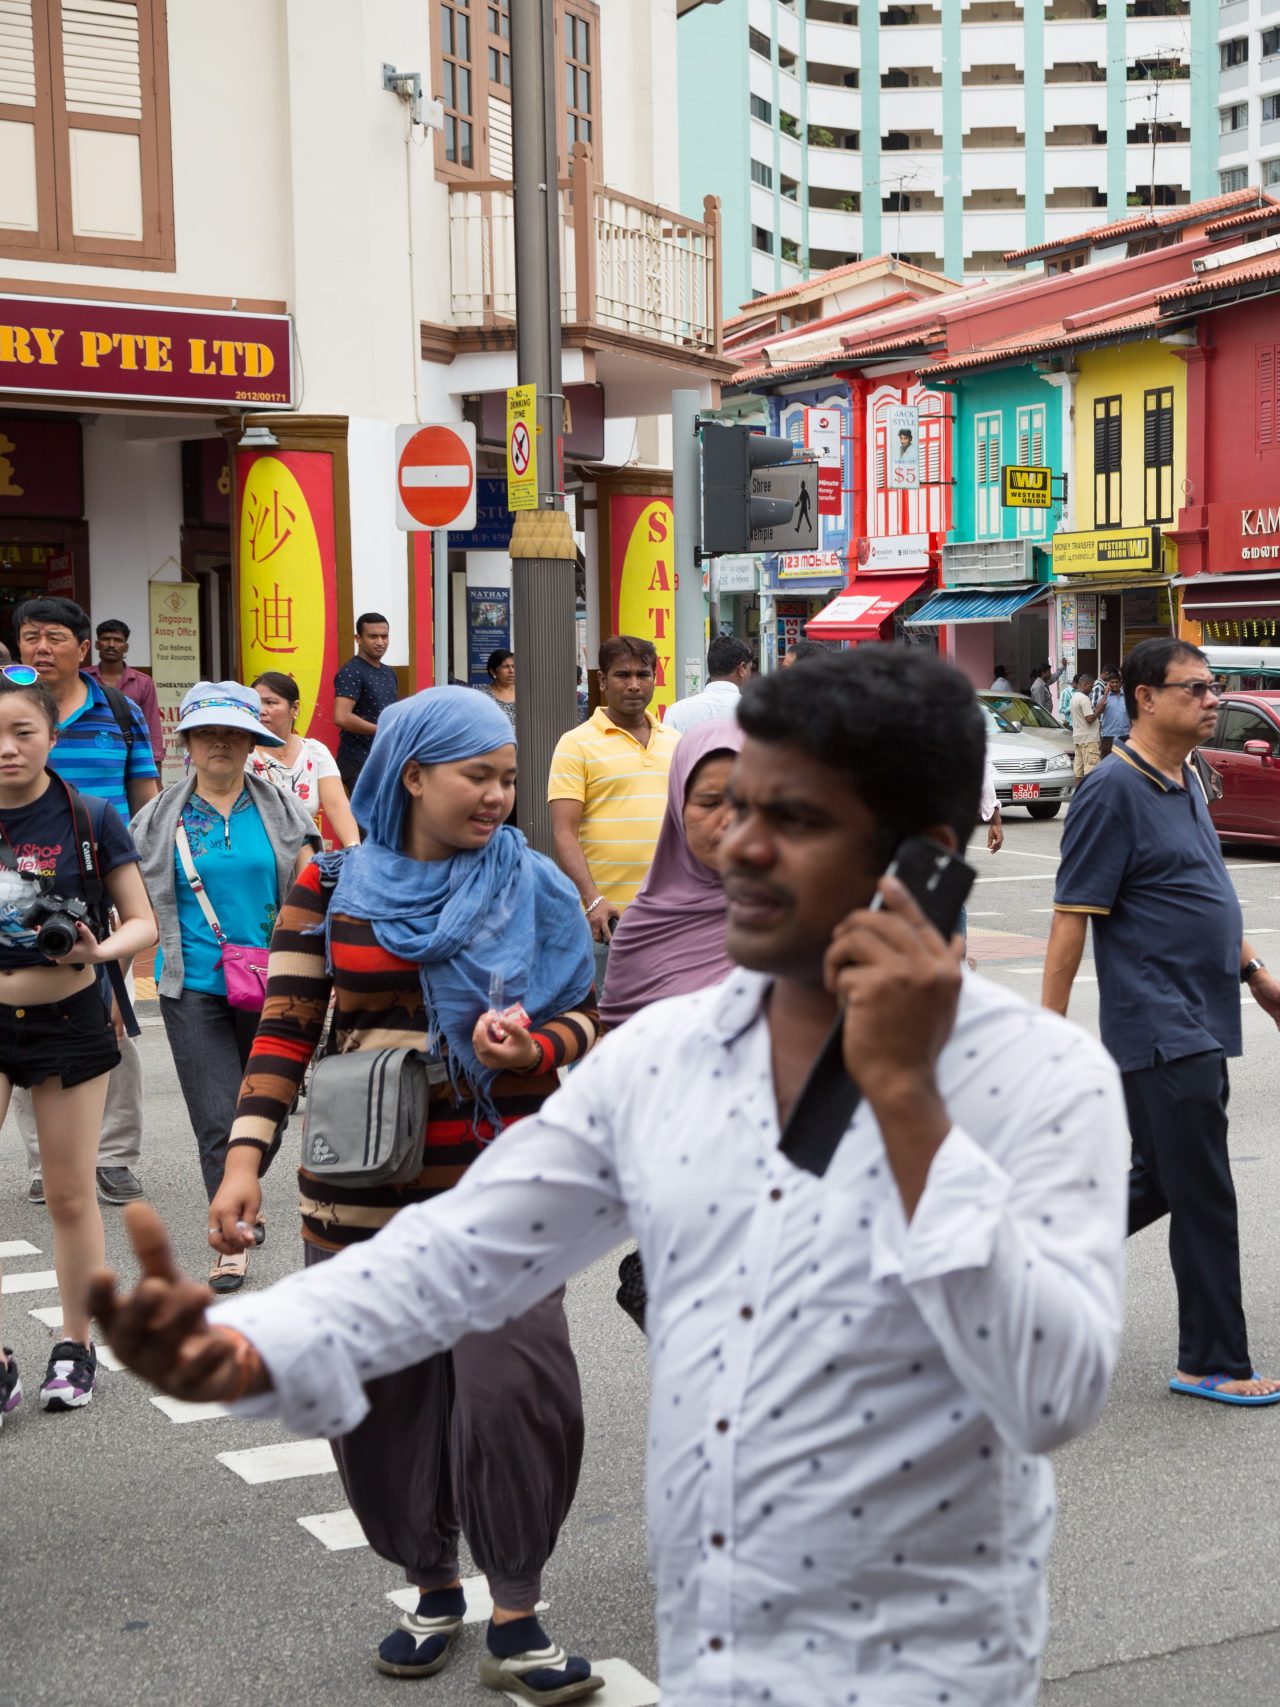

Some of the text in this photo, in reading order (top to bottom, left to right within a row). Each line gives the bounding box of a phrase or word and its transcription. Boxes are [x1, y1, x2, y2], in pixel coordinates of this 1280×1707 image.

[80, 331, 173, 372] PTE
[188, 338, 275, 378] LTD
[235, 390, 287, 402] 2012/00171
[894, 410, 914, 418] JACK
[894, 467, 916, 483] $5
[752, 478, 772, 494] Shree
[477, 506, 515, 519] STU
[750, 528, 774, 545] emple
[1054, 541, 1095, 550] MONEY TRANSFER
[1098, 540, 1127, 550] WESTERN
[1107, 549, 1127, 558] UNION
[1241, 543, 1280, 560] கமலா
[783, 556, 799, 568] 123
[248, 489, 299, 680] 沙迪
[158, 614, 193, 625] Singapore
[154, 627, 197, 637] Assay Office
[1018, 784, 1034, 792] SJV
[22, 843, 62, 858] Shoe
[82, 841, 93, 871] Canon
